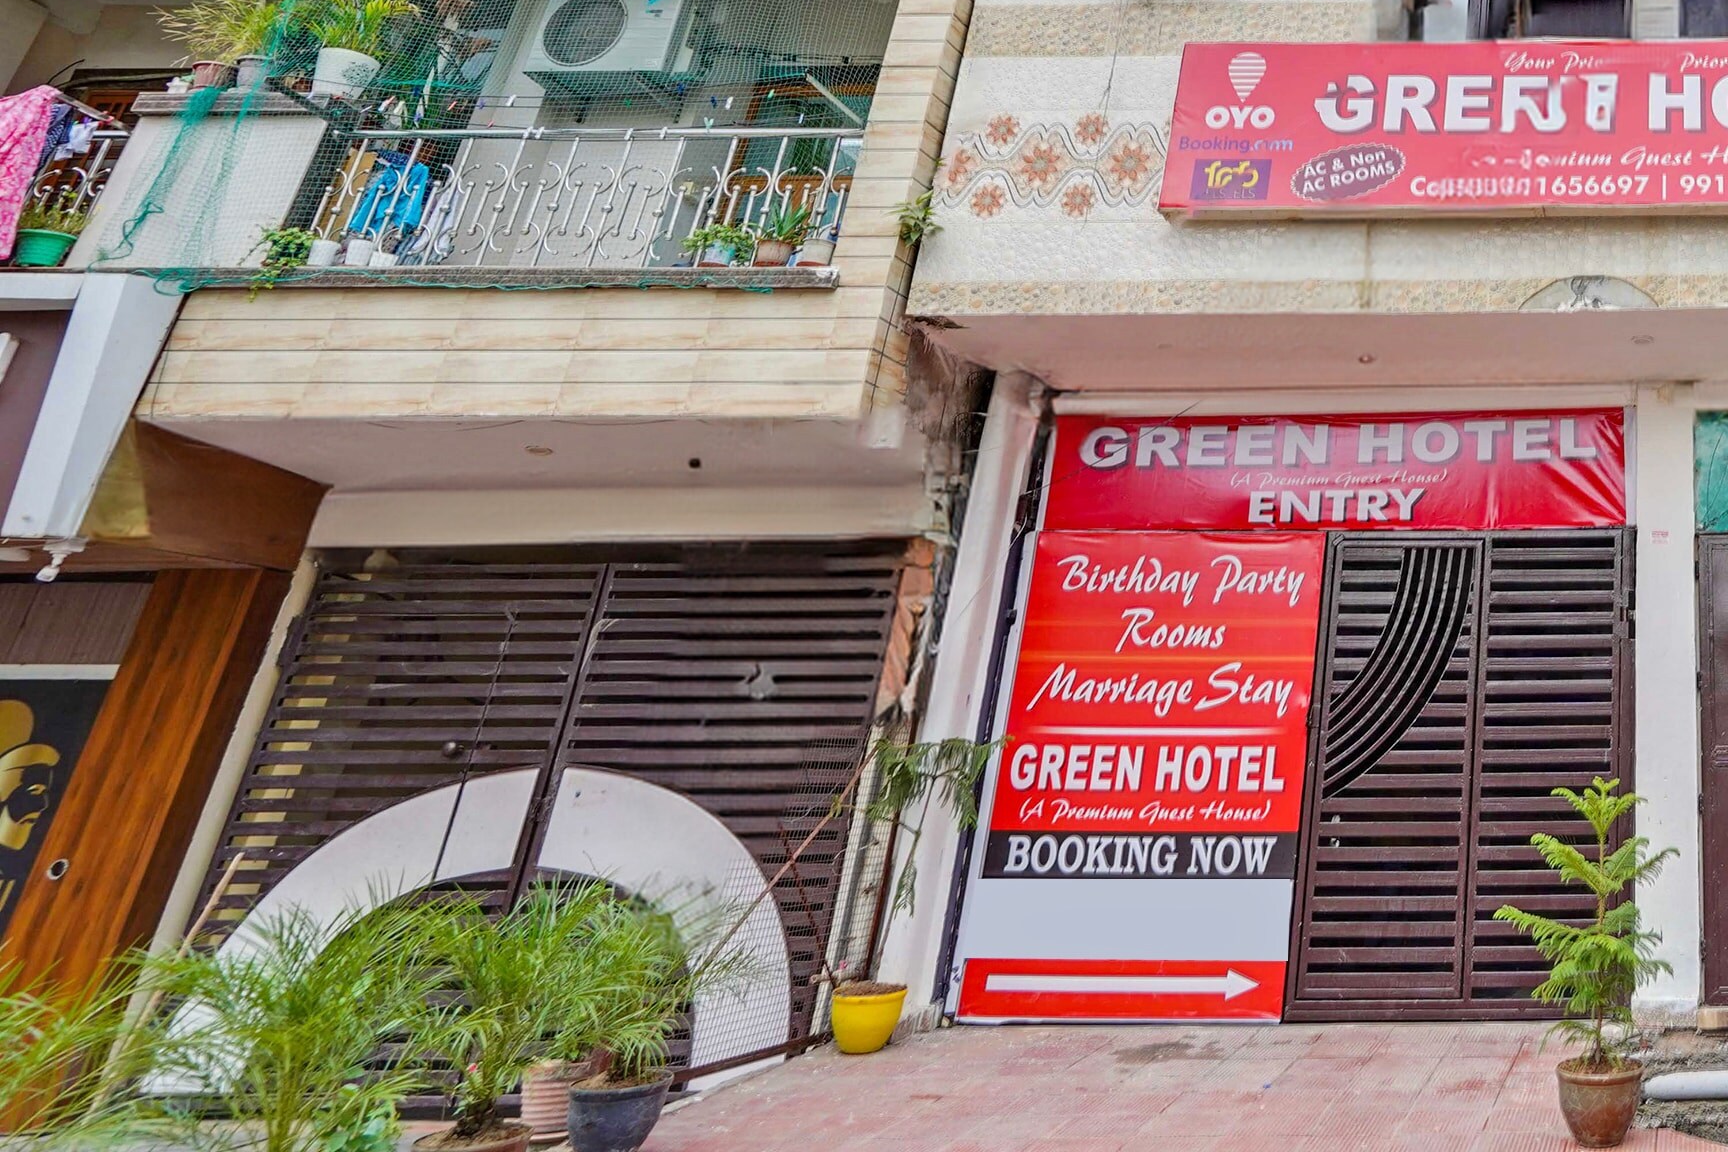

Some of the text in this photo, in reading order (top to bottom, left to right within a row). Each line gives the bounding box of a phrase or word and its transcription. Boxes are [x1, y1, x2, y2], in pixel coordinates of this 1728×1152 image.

[1504, 51, 1554, 72] Your
[1205, 105, 1275, 130] OYO
[1304, 150, 1386, 178] AC & Non
[1620, 146, 1692, 171] Guest
[1302, 178, 1325, 194] AC
[1330, 160, 1395, 187] ROOMS
[1080, 419, 1598, 468] GREEN HOTEL
[1230, 468, 1448, 489] (A Premium Guest House)
[1248, 488, 1425, 523] ENTRY
[1057, 554, 1305, 608] Birthday Party
[1115, 608, 1226, 653] Rooms
[1026, 662, 1294, 718] Marriage Stay
[1010, 744, 1285, 791] GREEN HOTEL
[1019, 797, 1271, 825] (A Premium Guest House)
[1004, 835, 1277, 875] BOOKING NOW
